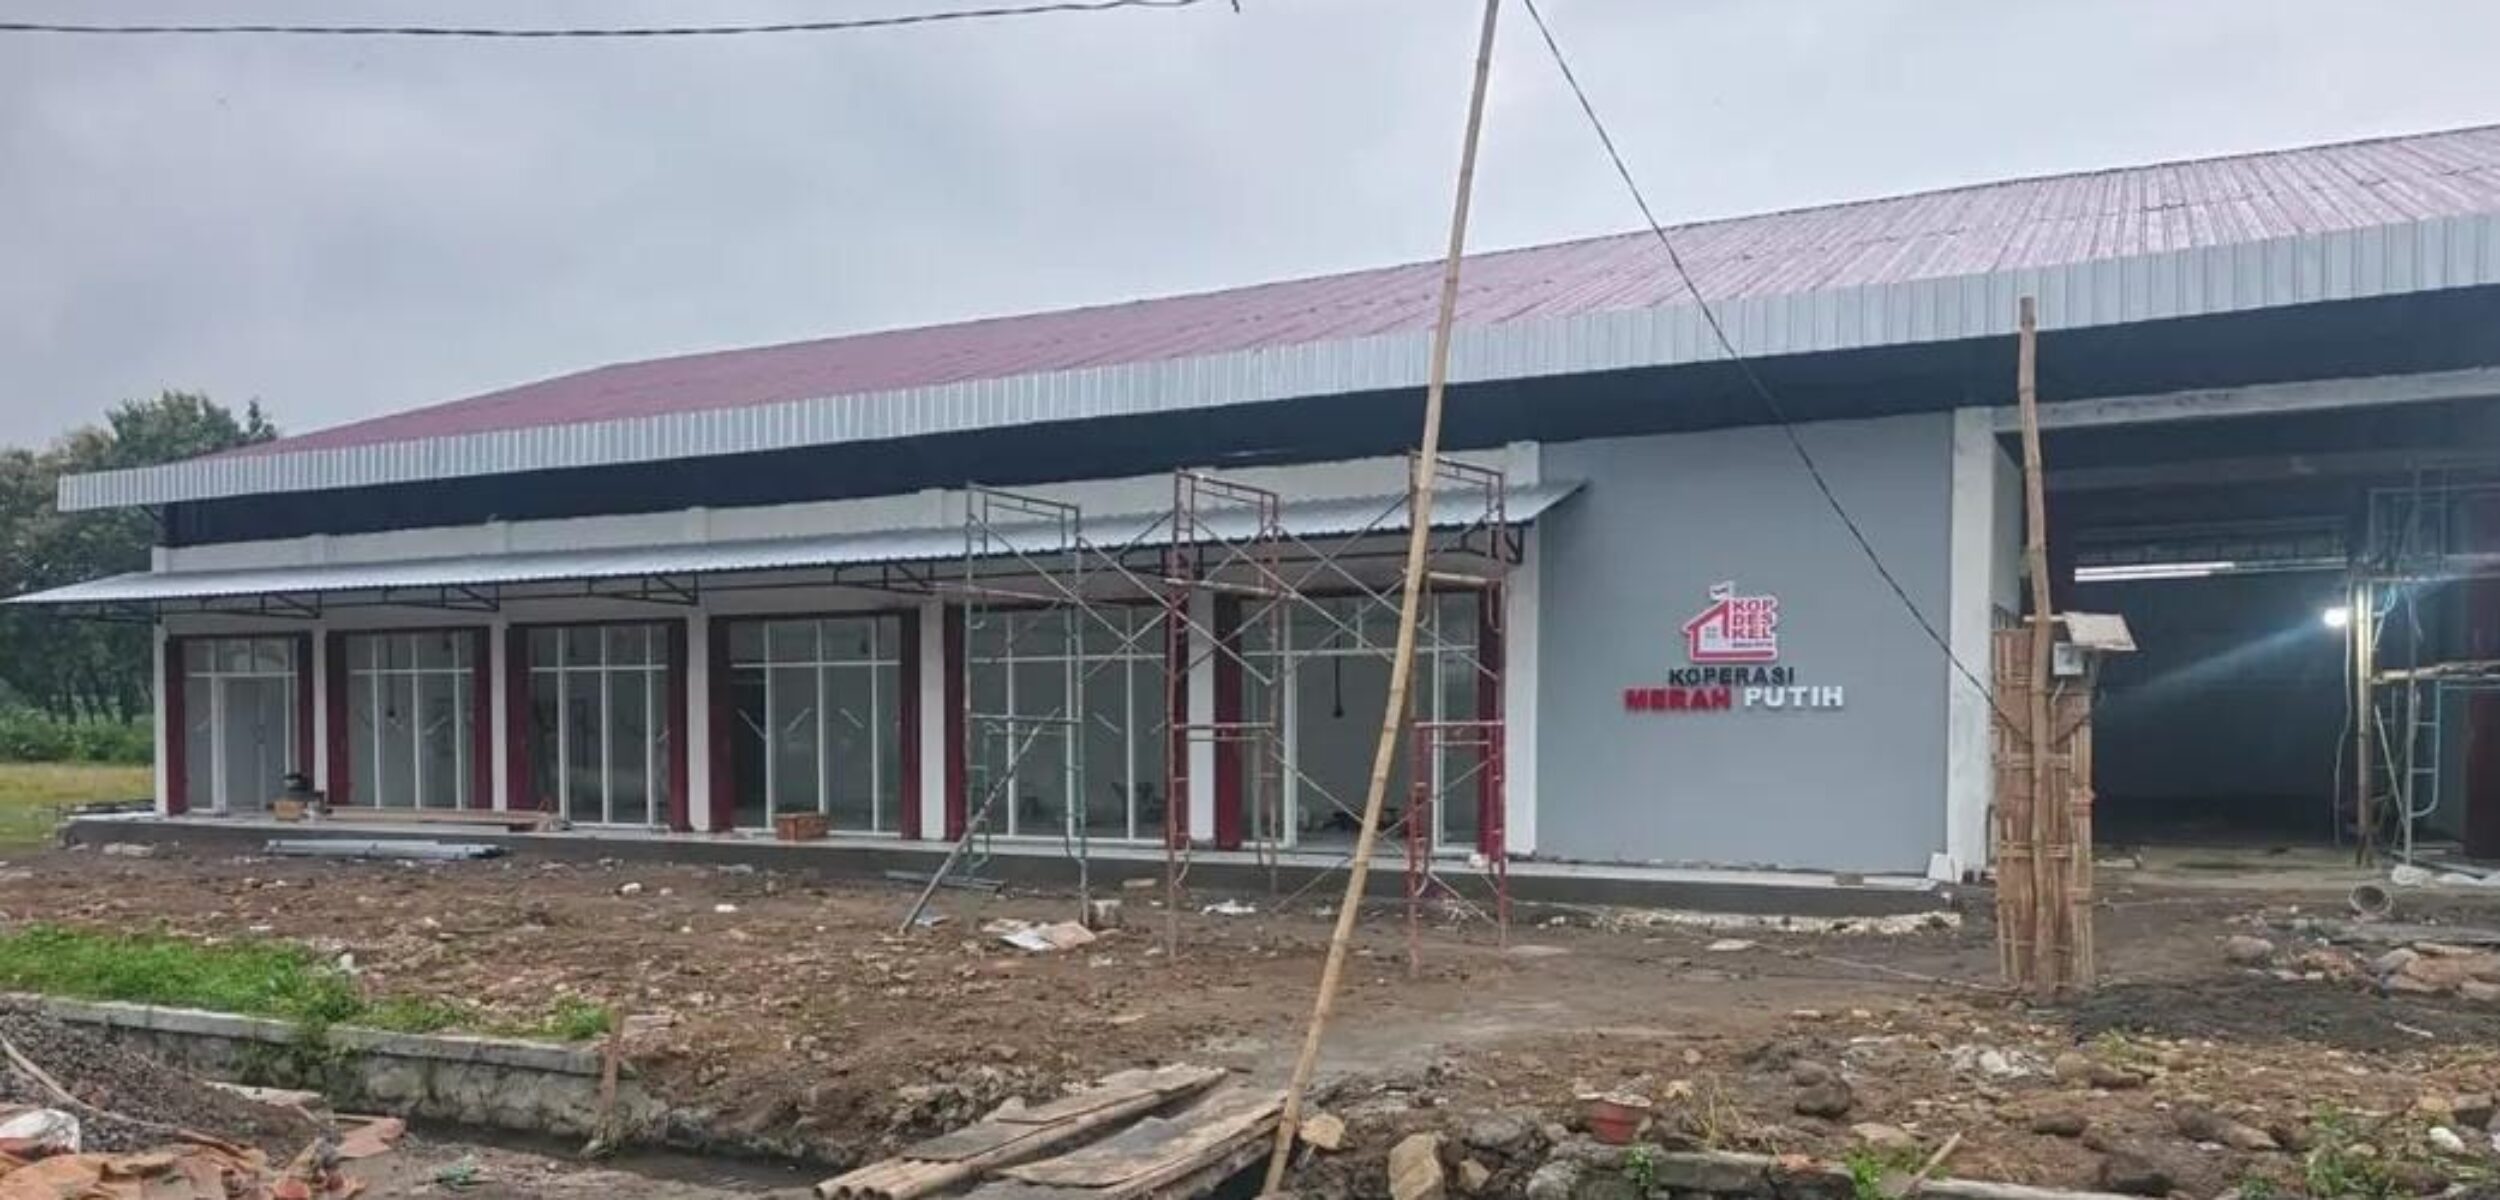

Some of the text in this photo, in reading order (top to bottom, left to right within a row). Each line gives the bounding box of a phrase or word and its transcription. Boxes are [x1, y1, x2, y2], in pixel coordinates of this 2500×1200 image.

[1733, 599, 1774, 613] KOP
[1733, 613, 1773, 626] DES
[1732, 627, 1773, 639] KEL
[1668, 667, 1795, 686] KOPERASI
[1624, 686, 1844, 711] MERAH PUTIH
